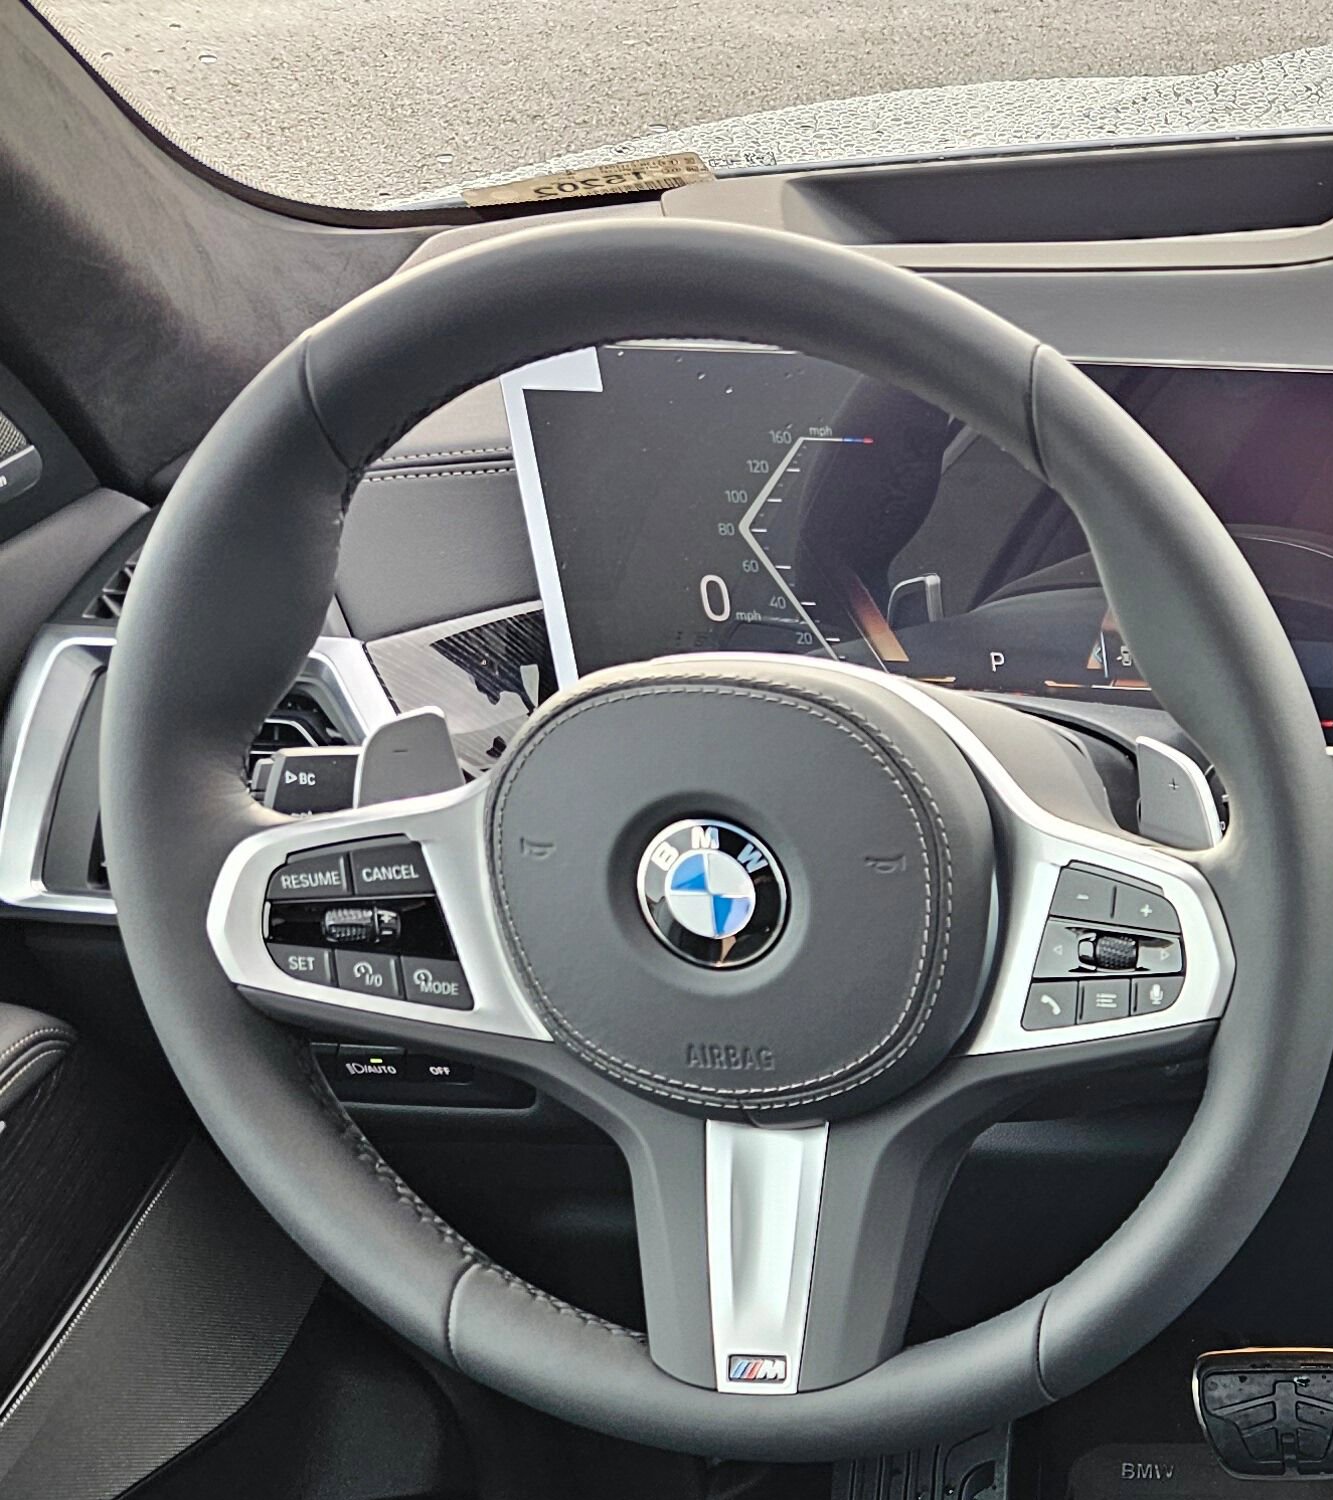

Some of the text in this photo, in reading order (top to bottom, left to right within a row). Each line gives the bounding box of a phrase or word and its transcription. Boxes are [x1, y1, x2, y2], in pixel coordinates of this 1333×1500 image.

[769, 430, 792, 444] 160
[809, 425, 832, 437] mph
[746, 460, 769, 473] 120
[724, 490, 748, 503] 100
[718, 523, 735, 536] 80
[742, 560, 759, 573] 60
[700, 574, 731, 622] 0
[769, 597, 787, 610] 40
[736, 609, 762, 622] mph
[796, 632, 813, 644] 20
[990, 652, 1005, 672] P
[299, 772, 316, 786] BC
[651, 826, 769, 873] BMW
[281, 871, 341, 889] RESUME
[362, 864, 419, 883] CANCEL
[288, 956, 315, 971] SET
[420, 980, 459, 996] MODE
[685, 1043, 776, 1071] AIRBAG
[429, 1066, 450, 1075] OFF
[1121, 1462, 1174, 1480] BMW
